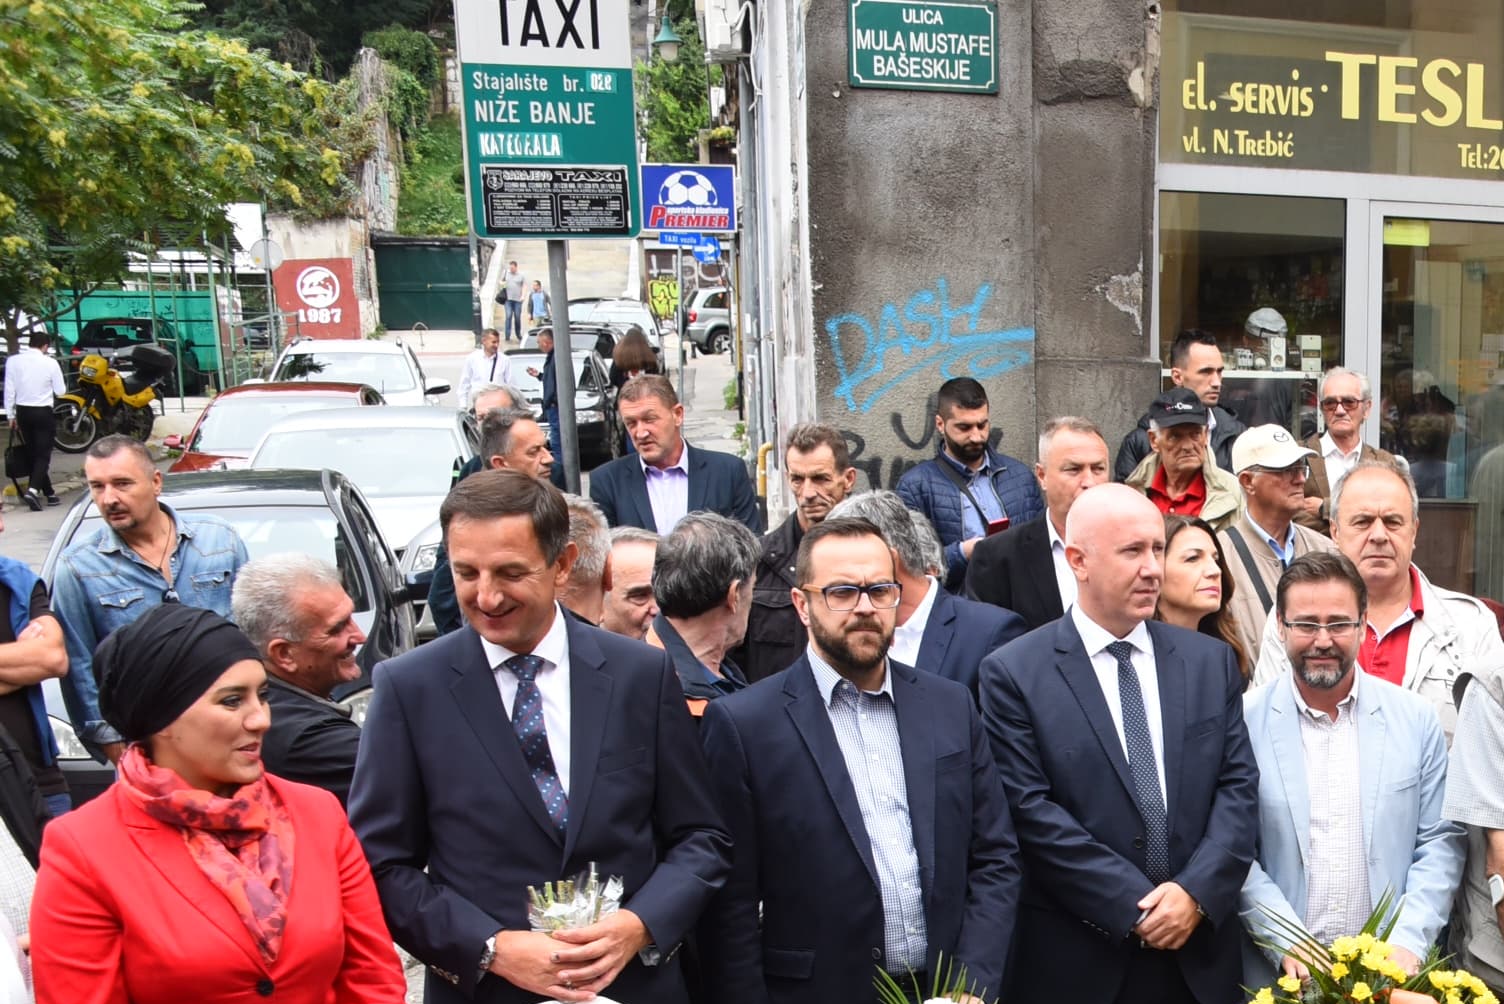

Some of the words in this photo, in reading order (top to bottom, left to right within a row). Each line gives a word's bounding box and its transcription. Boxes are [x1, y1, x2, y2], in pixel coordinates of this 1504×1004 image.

[499, 0, 600, 49] TAXI
[902, 8, 943, 25] ULICA
[856, 28, 905, 52] MULA
[910, 32, 990, 56] MUSTAFE
[873, 53, 971, 80] BAŠESKIJE
[473, 71, 548, 94] Stajalište
[563, 74, 584, 92] br.
[475, 95, 520, 123] NIŽE
[530, 101, 596, 124] BANJE
[1183, 126, 1206, 154] vl.
[555, 171, 621, 182] TAXI
[649, 205, 729, 228] PREMIER
[298, 308, 342, 323] 1987
